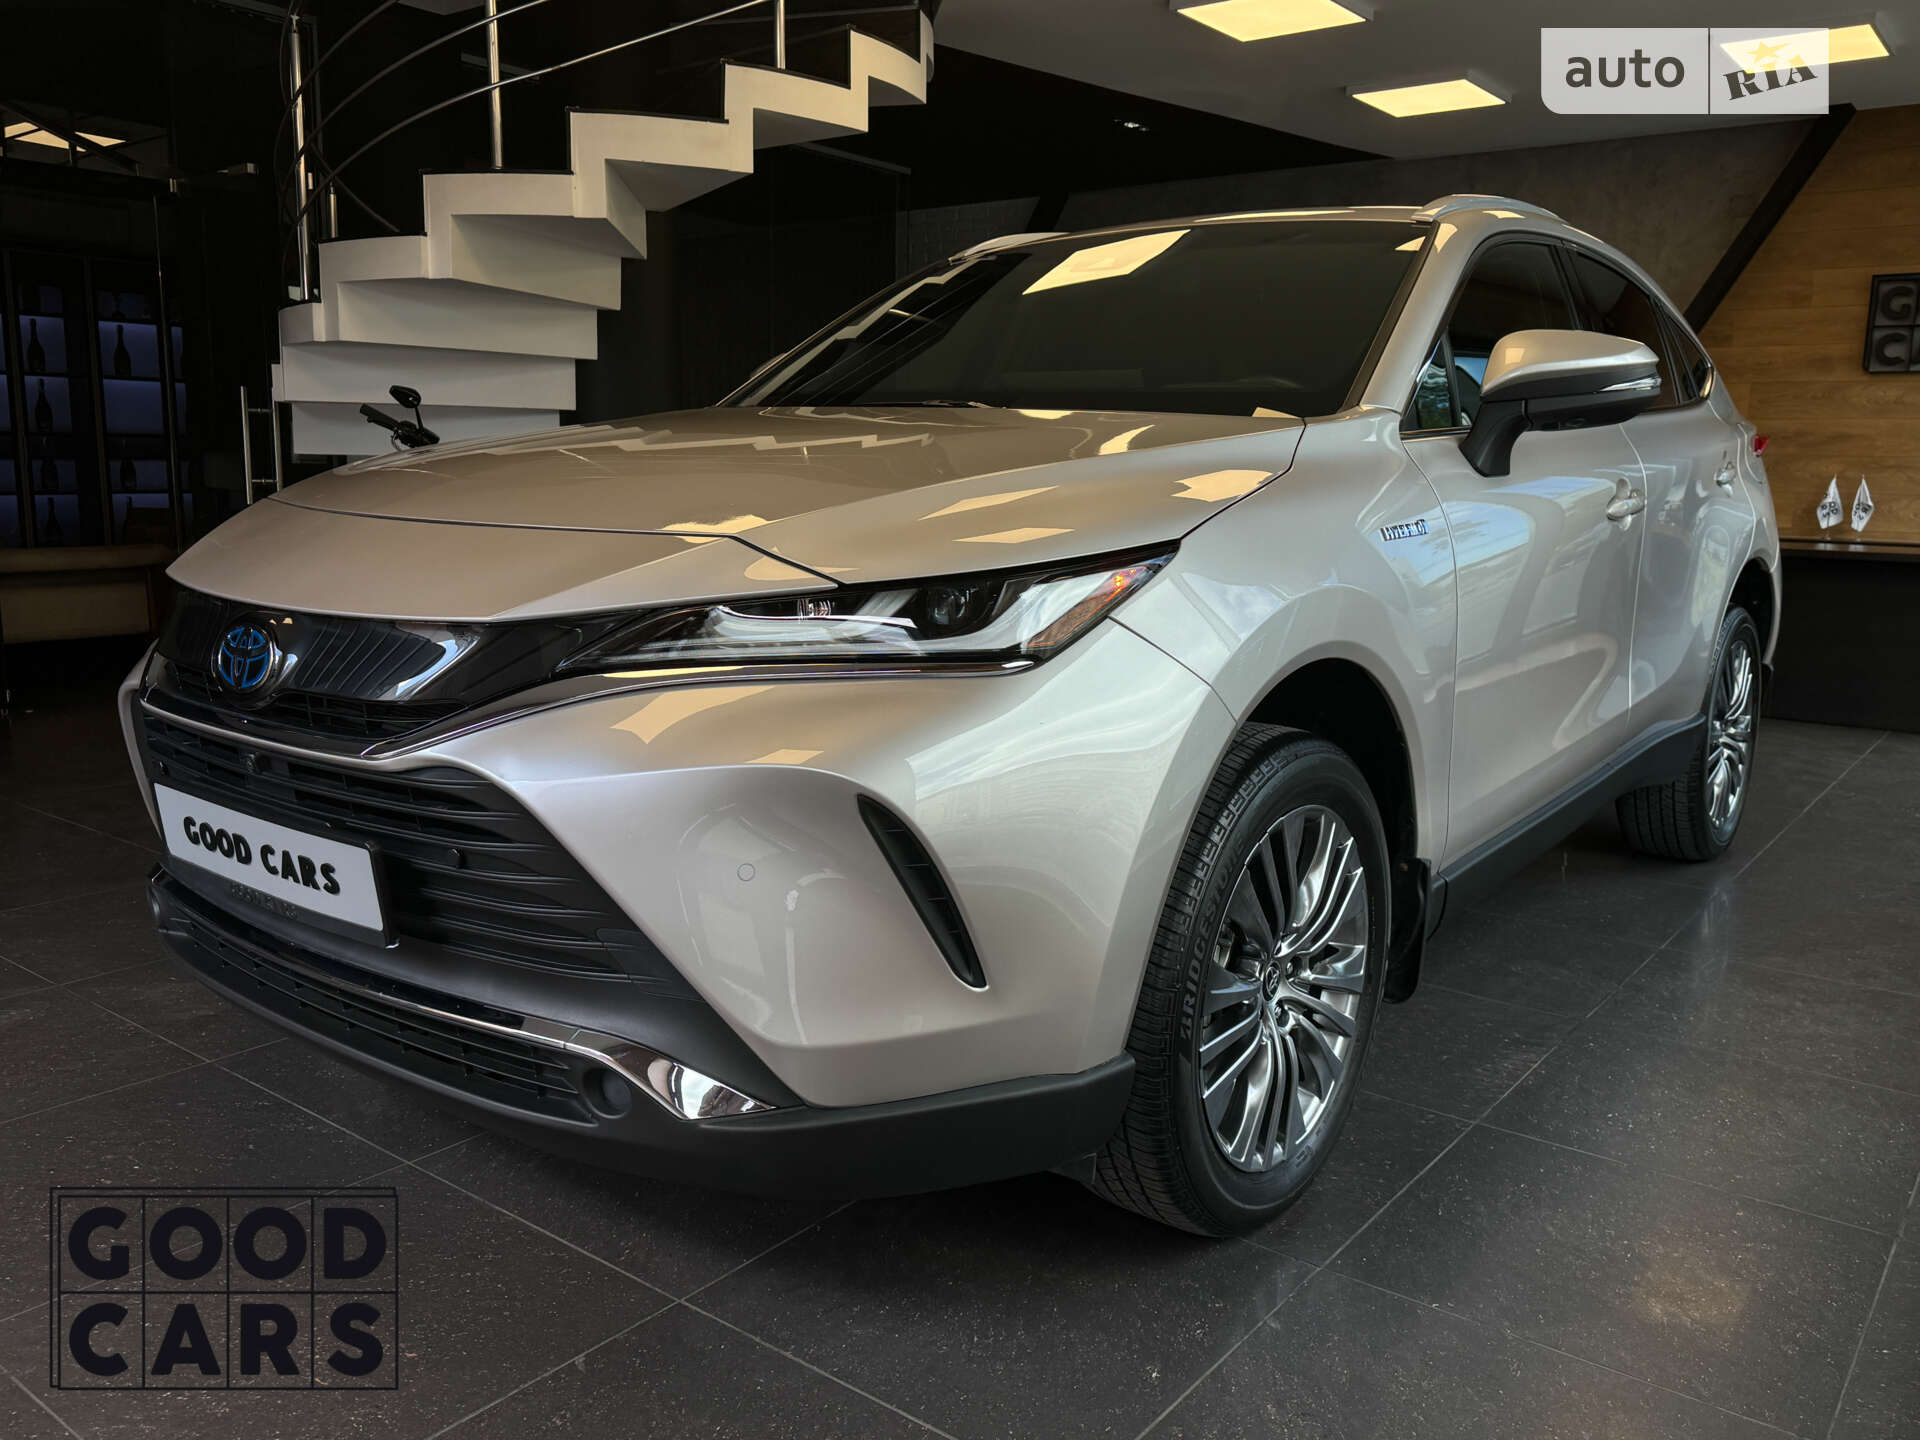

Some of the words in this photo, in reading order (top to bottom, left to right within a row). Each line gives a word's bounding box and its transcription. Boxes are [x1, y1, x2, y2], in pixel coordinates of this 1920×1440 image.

[1876, 332, 1920, 366] C
[183, 815, 252, 865] GOOD
[260, 844, 341, 895] CARS
[1178, 836, 1245, 1041] BRIDGESTONE
